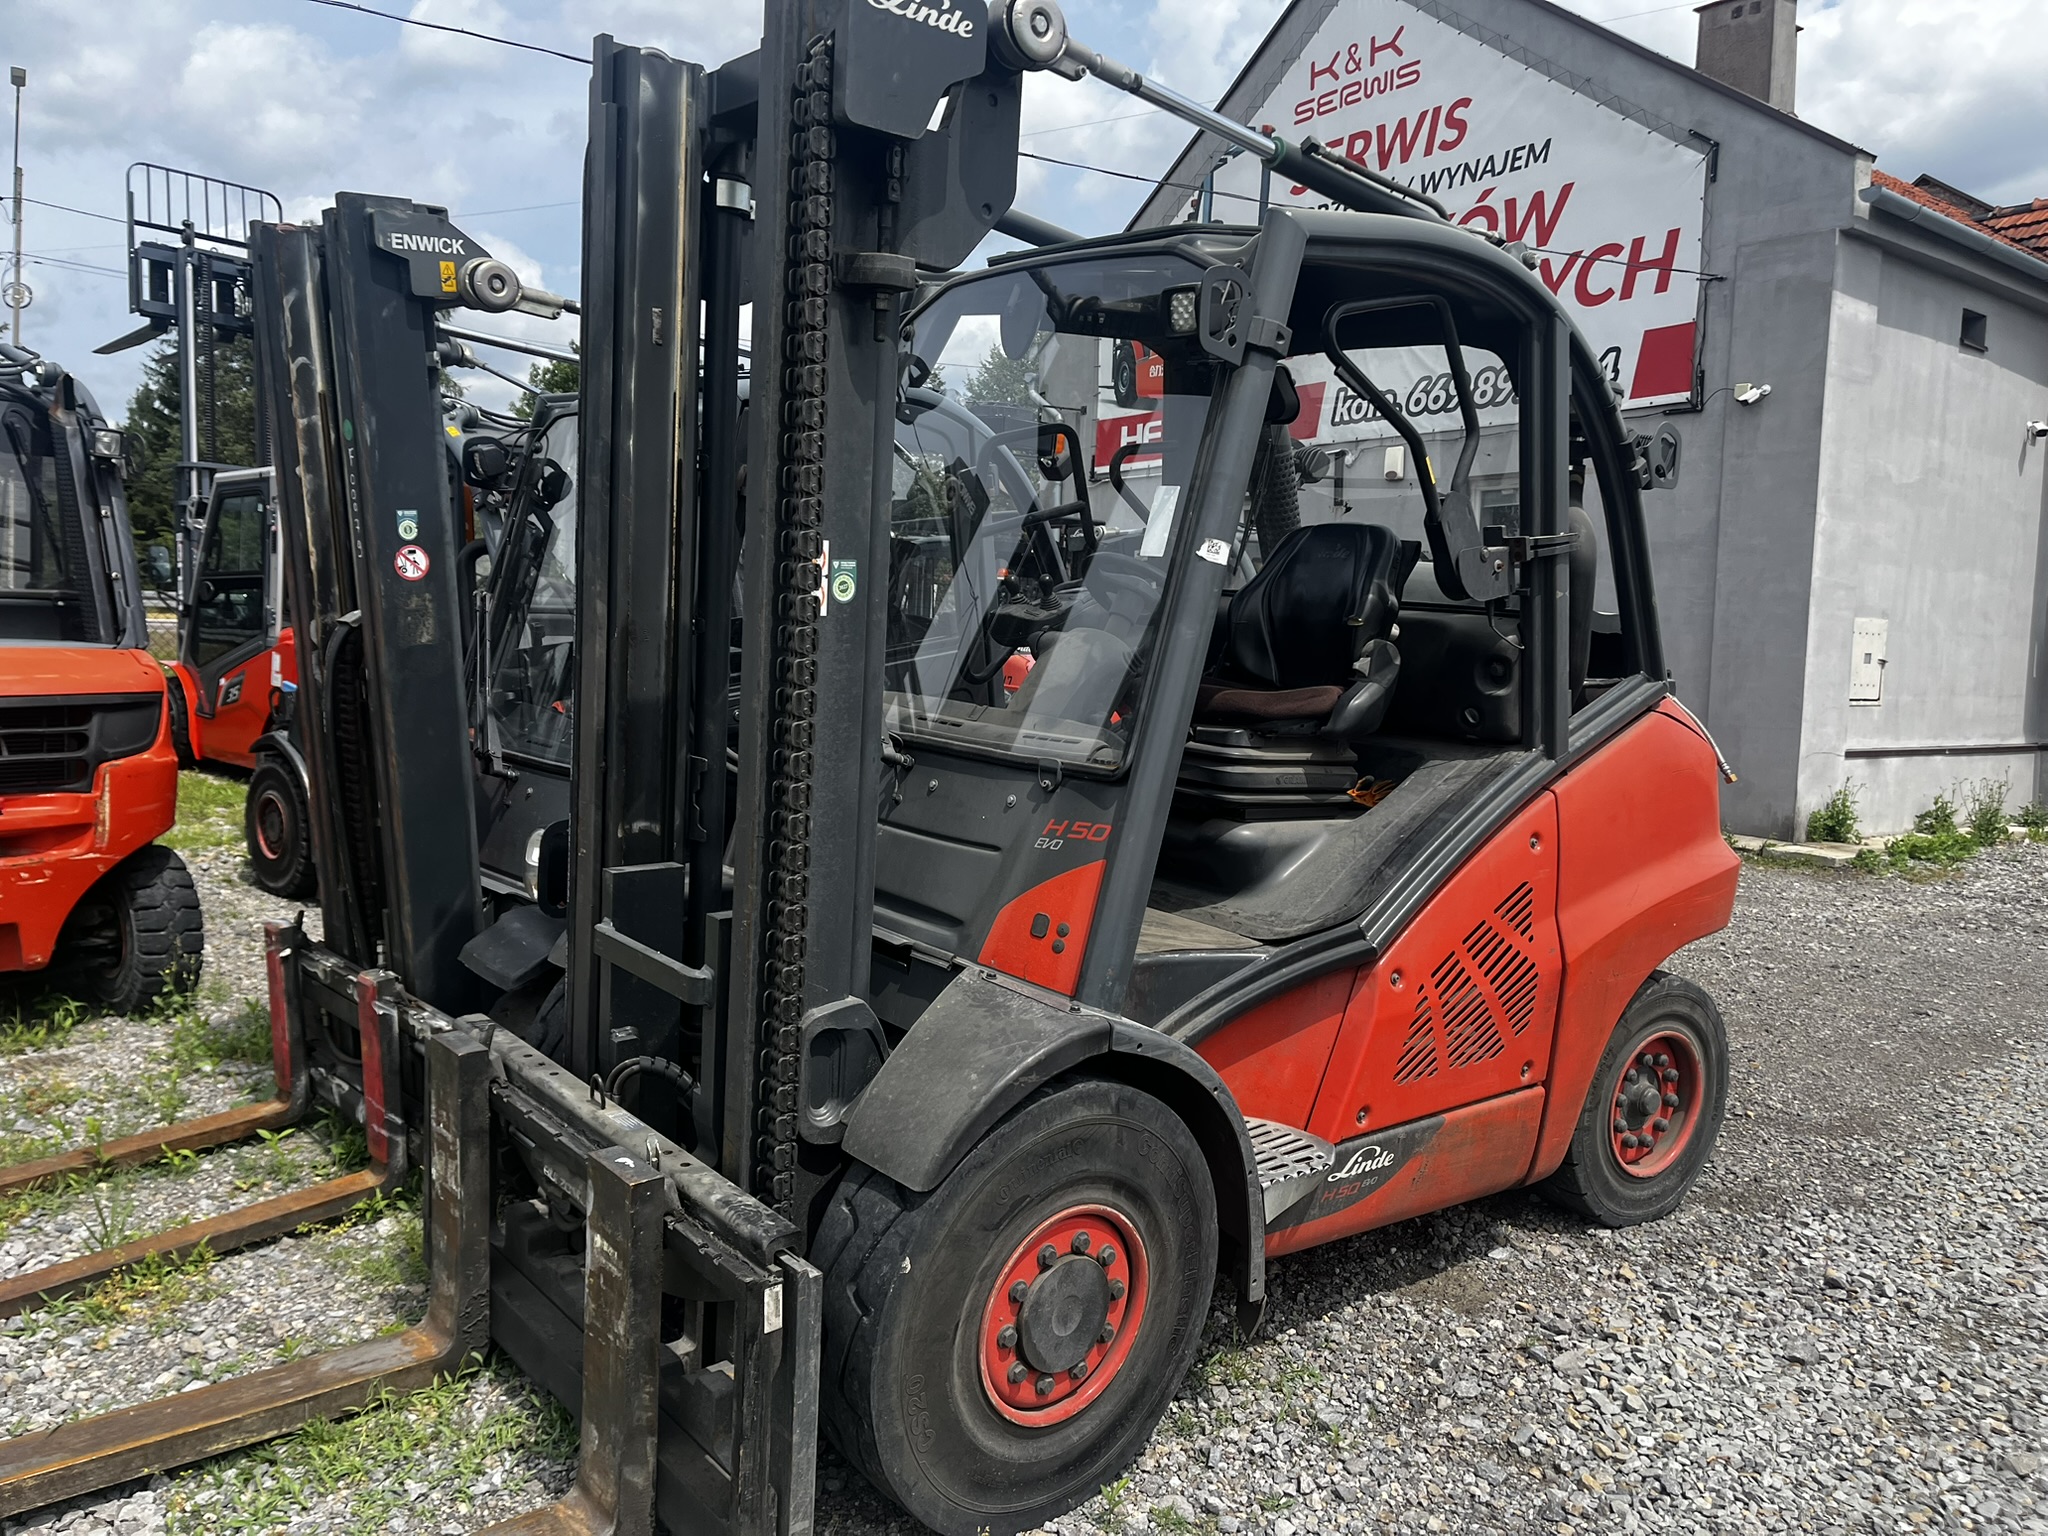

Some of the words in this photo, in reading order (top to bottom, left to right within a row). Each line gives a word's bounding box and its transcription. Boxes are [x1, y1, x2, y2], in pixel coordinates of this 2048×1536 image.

[1294, 59, 1421, 126] SERWIS
[1289, 97, 1473, 196] RWIS
[1421, 138, 1552, 195] WYNAJEM
[388, 232, 466, 255] ENWICK
[1540, 228, 1681, 307] YCH
[1034, 837, 1063, 851] EVO
[1327, 1145, 1395, 1182] Linde
